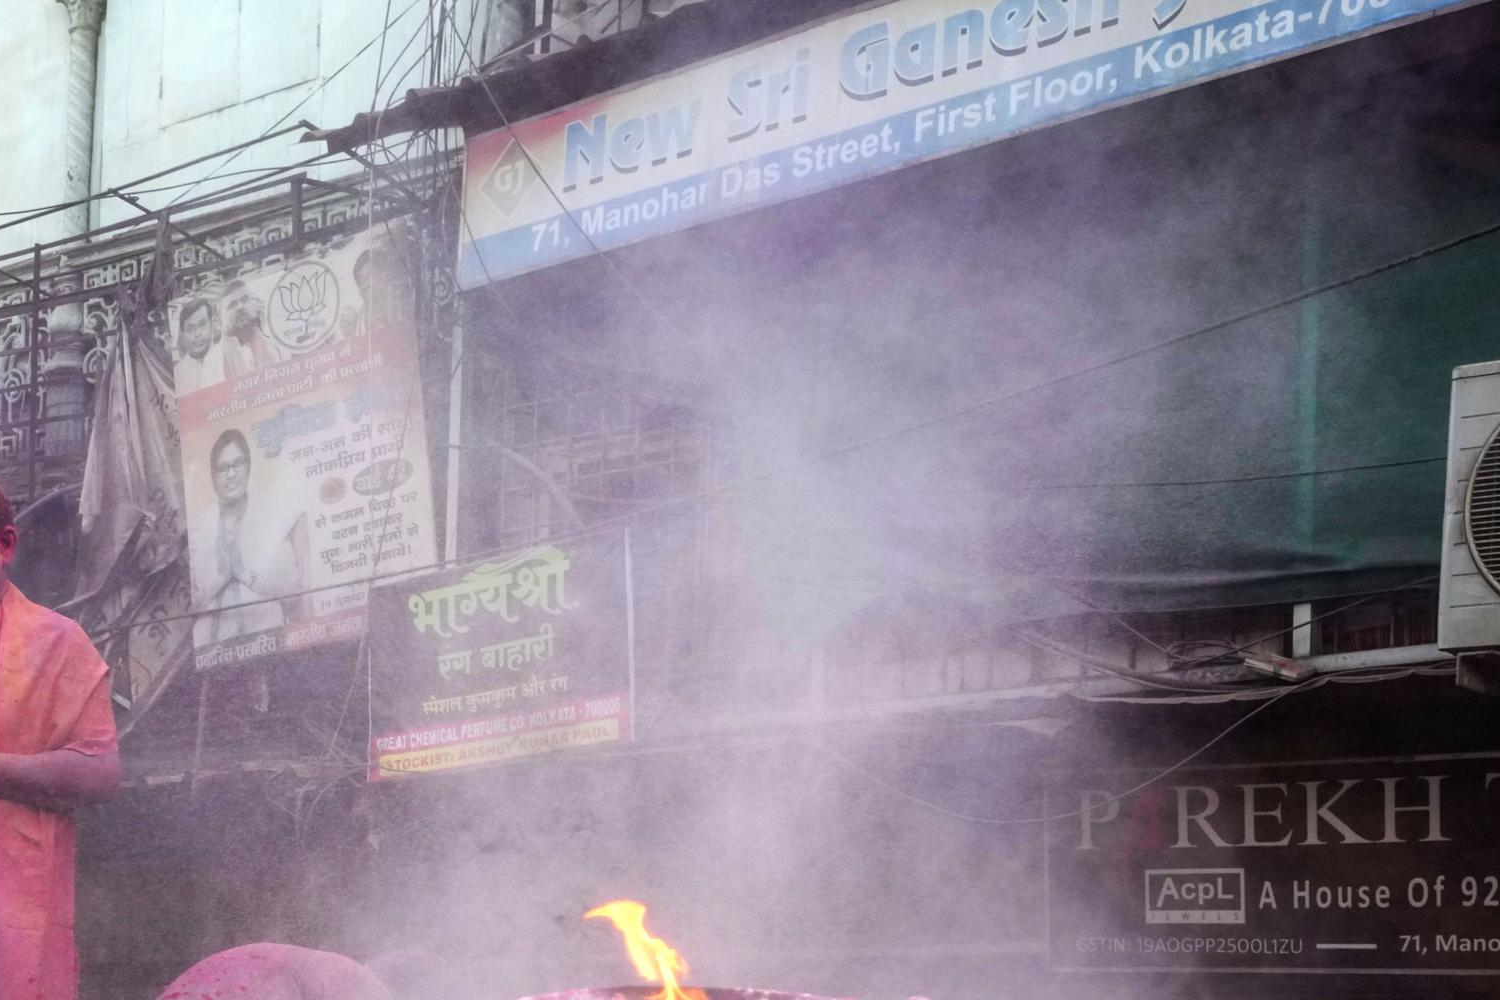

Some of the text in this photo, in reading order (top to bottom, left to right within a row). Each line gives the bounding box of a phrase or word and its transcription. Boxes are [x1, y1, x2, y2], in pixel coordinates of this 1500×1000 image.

[531, 220, 569, 252] 71,
[581, 183, 709, 236] Manohar
[721, 160, 780, 198] Das
[792, 123, 899, 177] Street,
[915, 90, 996, 143] First
[1009, 62, 1118, 116] Floor,
[1134, 0, 1390, 80] Kolkata-70
[563, 103, 699, 193] New
[726, 47, 812, 142] Sri
[408, 546, 579, 638] भाग्यश्री
[376, 735, 408, 752] GREAT
[410, 726, 457, 749] CHEMICAL
[461, 718, 507, 740] PERFUME
[529, 706, 576, 727] KOLKATA
[518, 732, 570, 752] KUMAR
[572, 725, 612, 744] PAUL
[1156, 877, 1234, 907] AcpL
[1259, 881, 1277, 910] A
[1293, 880, 1391, 909] House
[1408, 875, 1445, 907] Of
[1399, 934, 1428, 955] 71,
